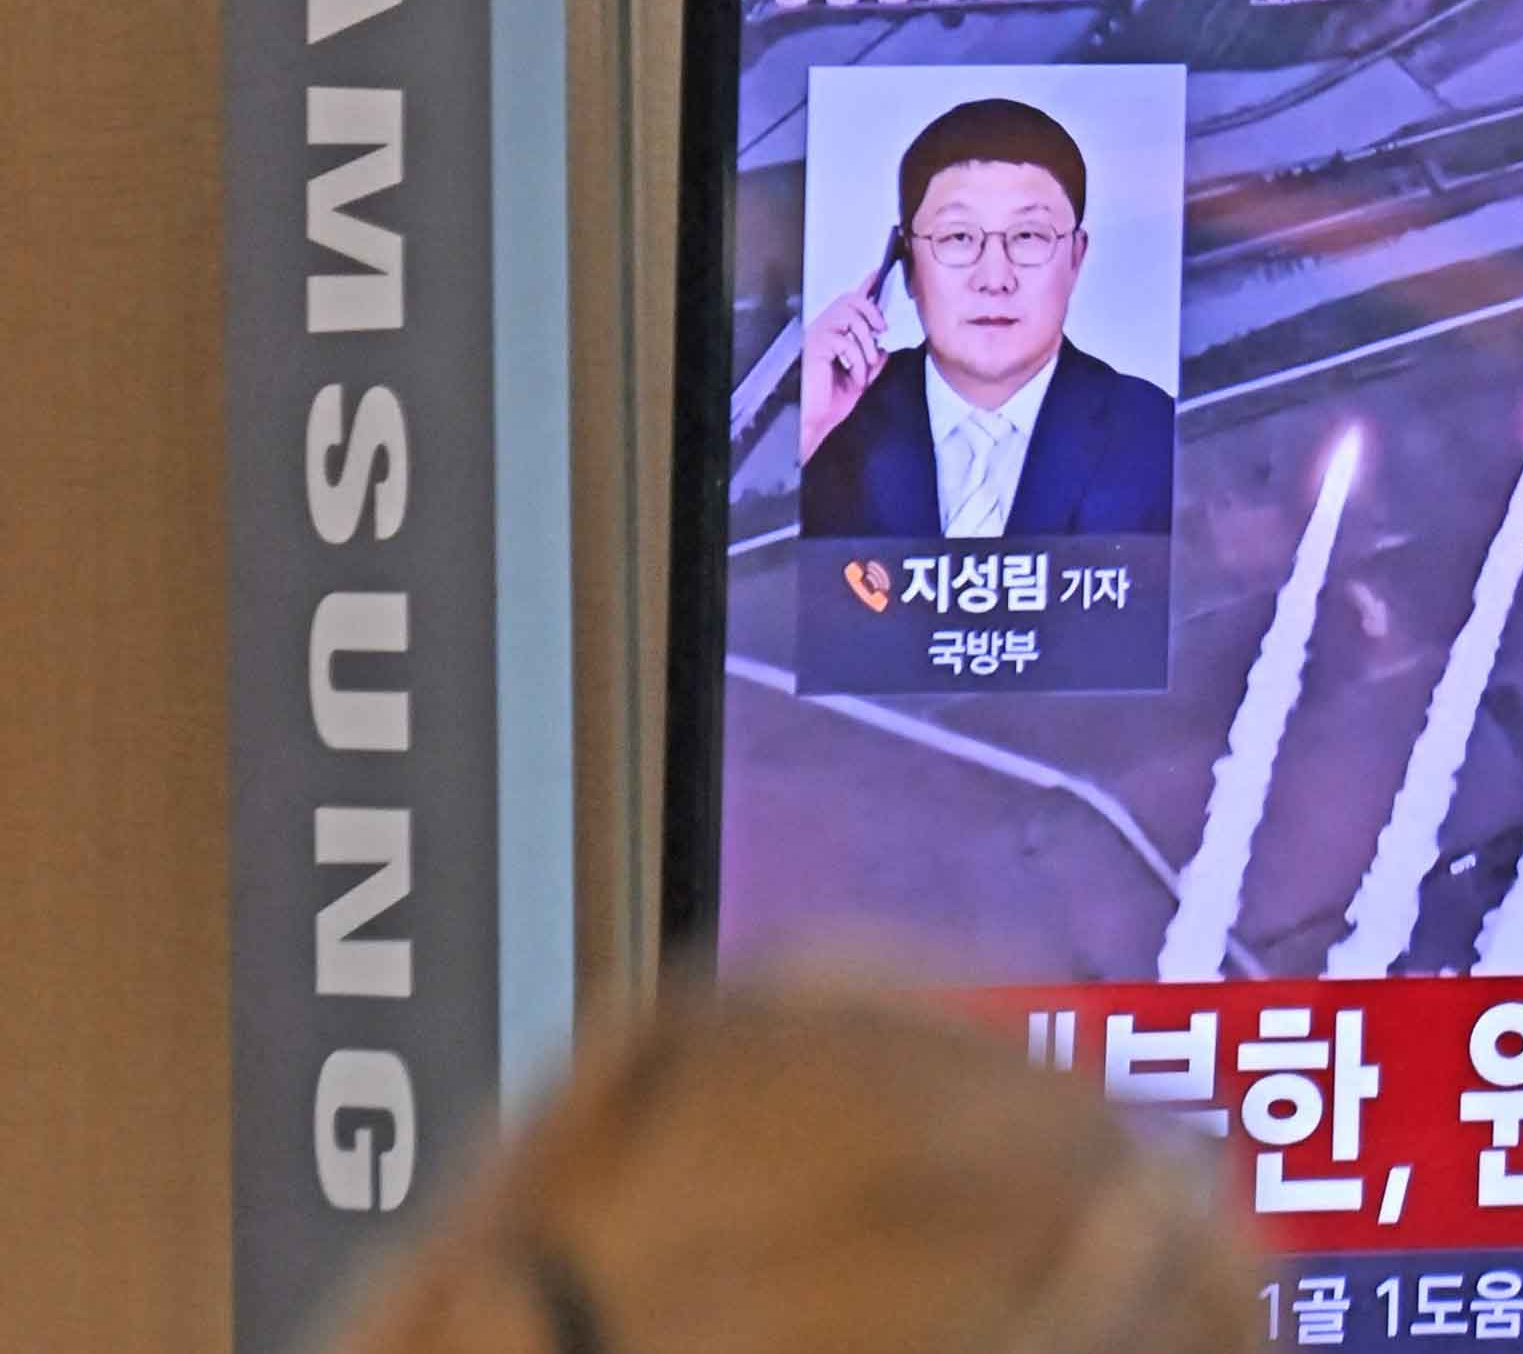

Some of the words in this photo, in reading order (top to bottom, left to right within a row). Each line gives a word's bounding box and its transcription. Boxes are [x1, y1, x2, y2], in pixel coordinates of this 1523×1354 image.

[901, 554, 1048, 614] 지성림
[1059, 566, 1131, 610] 기자
[927, 630, 1041, 676] 국방부
[1258, 1272, 1351, 1346] 1골
